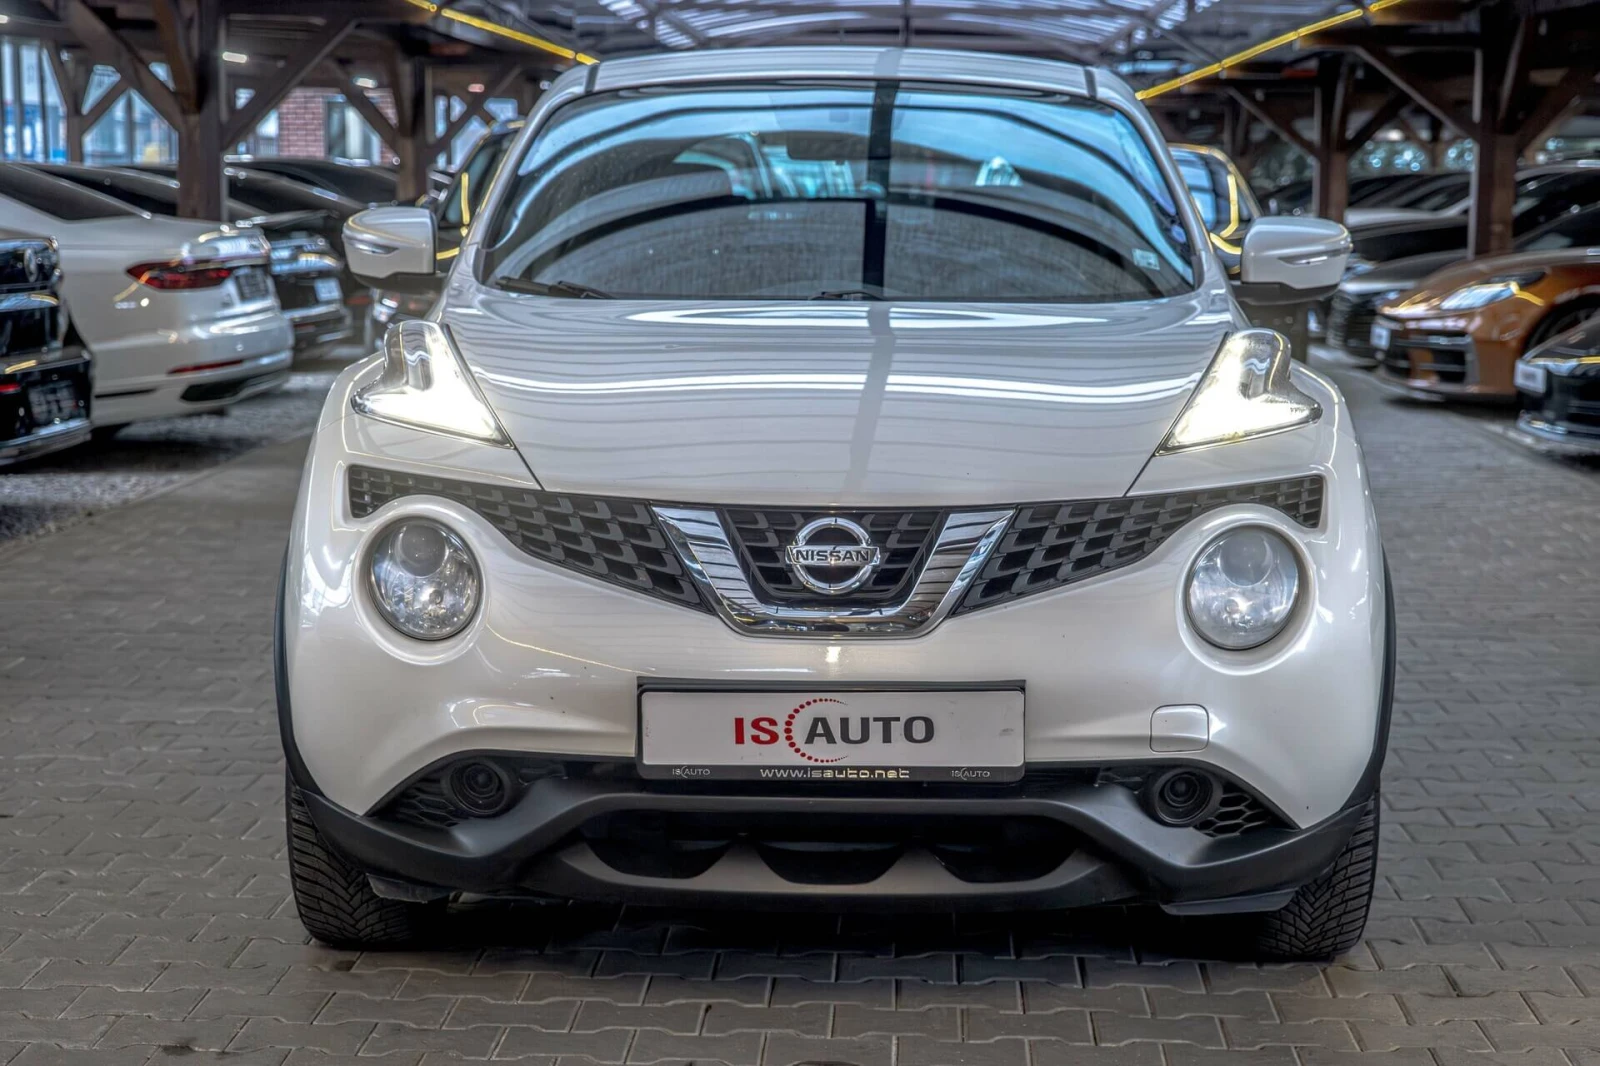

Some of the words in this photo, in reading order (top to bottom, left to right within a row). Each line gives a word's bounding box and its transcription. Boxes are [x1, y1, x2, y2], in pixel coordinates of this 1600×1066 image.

[795, 550, 869, 562] NISSAN
[804, 715, 935, 745] AUTO
[760, 767, 910, 779] www.isauto.net
